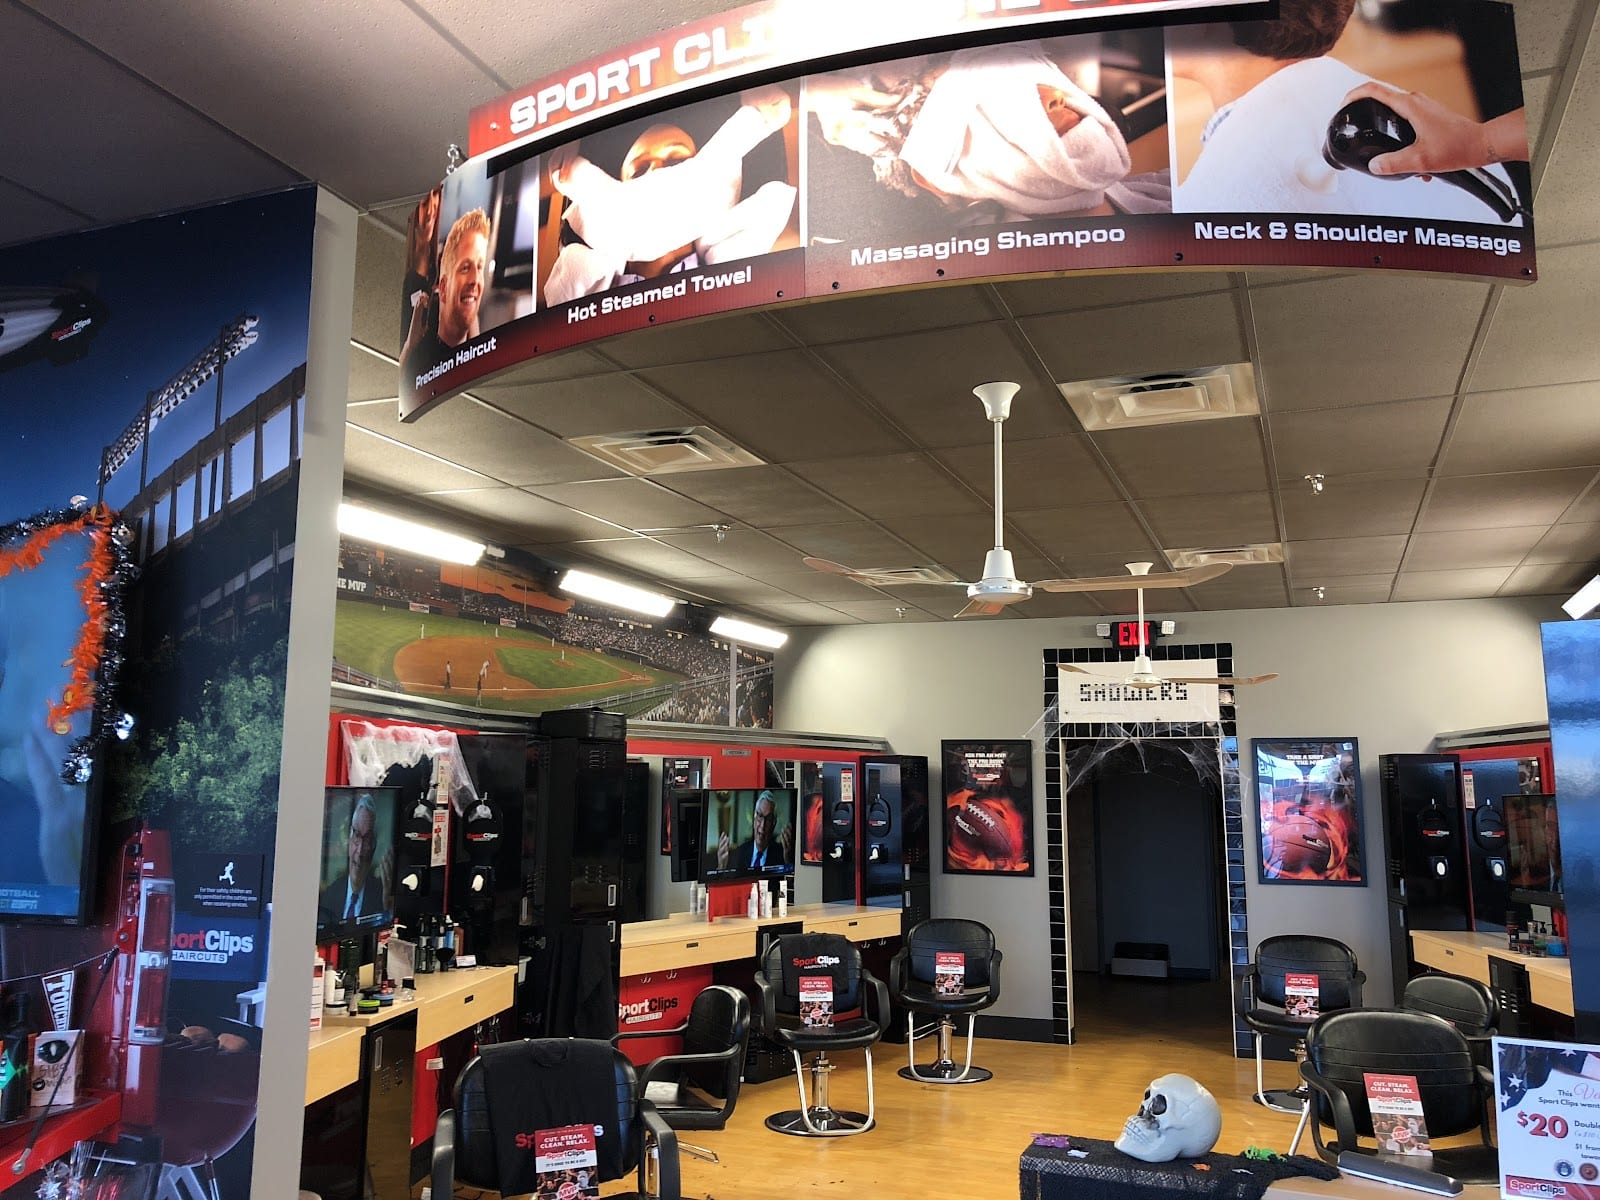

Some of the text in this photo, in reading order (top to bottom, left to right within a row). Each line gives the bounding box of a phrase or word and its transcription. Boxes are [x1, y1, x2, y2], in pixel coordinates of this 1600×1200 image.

[509, 47, 661, 135] SPORT
[851, 227, 1126, 267] Massaging Shampoo
[1194, 222, 1521, 256] Neck & Shoulder Massage
[567, 266, 752, 324] Hot Steamed Towel
[415, 336, 497, 391] Precision Haircut
[347, 579, 367, 592] MVP
[1118, 622, 1151, 646] EXT
[173, 929, 254, 956] ortClips
[793, 955, 840, 967] SportClips
[46, 974, 72, 1031] TOUCHD
[1538, 1096, 1559, 1105] Sport
[1560, 1098, 1578, 1107] Clips
[1557, 1089, 1573, 1097] This
[560, 1133, 586, 1141] STEAM.
[1517, 1110, 1569, 1139] $20
[540, 1141, 565, 1149] CLEAN.
[566, 1138, 590, 1147] RELAX.
[1511, 1180, 1566, 1195] SportClips
